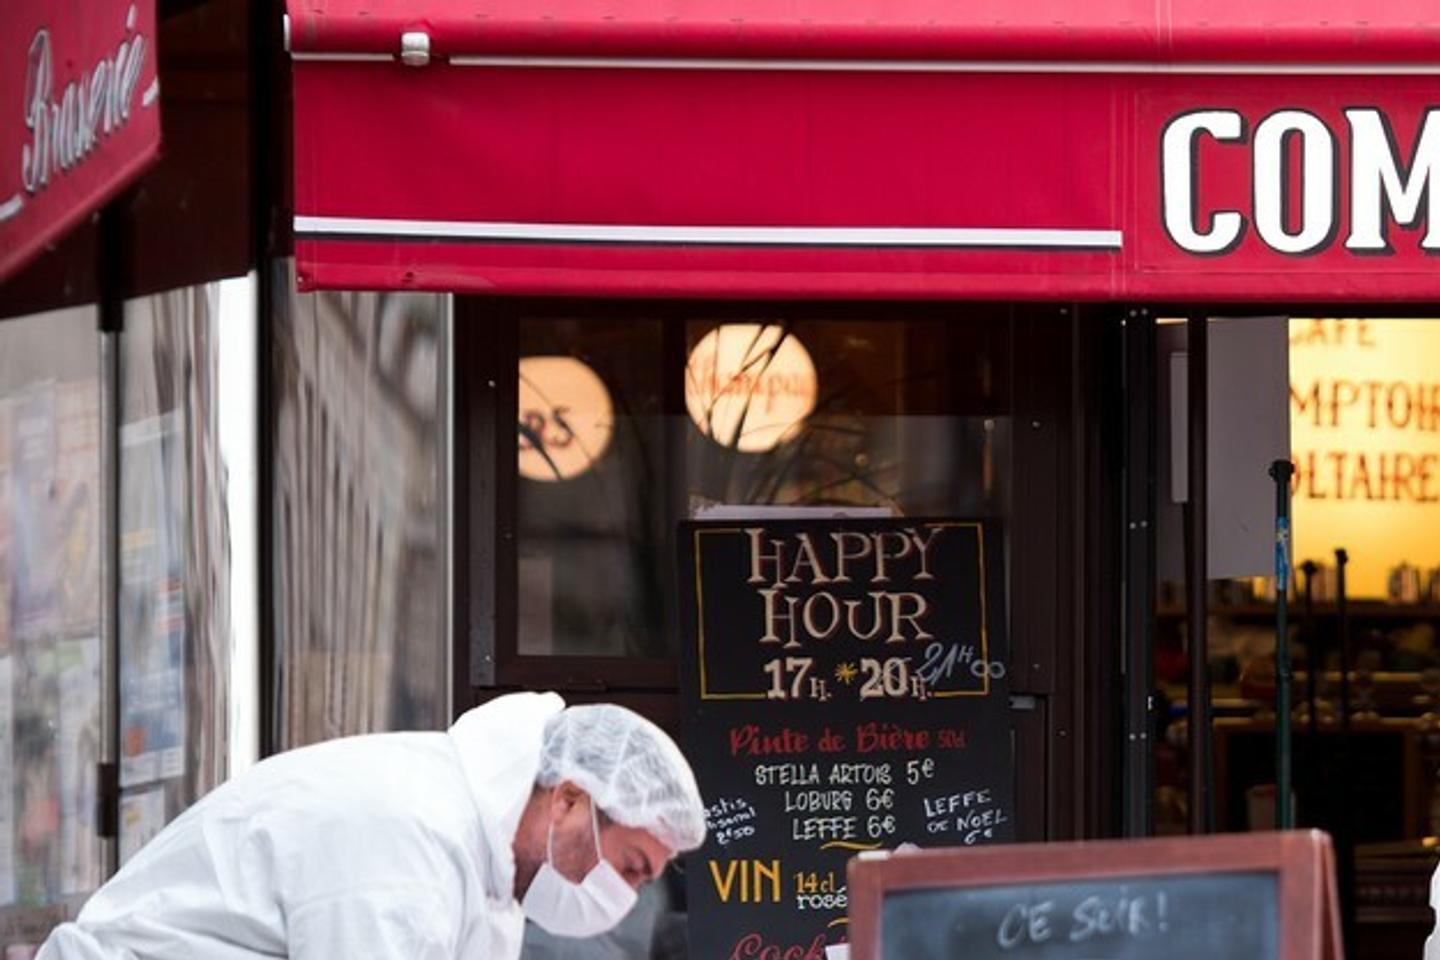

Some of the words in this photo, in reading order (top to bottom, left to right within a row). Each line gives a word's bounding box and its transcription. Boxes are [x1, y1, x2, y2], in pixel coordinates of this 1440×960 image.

[745, 527, 944, 589] HAPPY
[758, 589, 934, 648] HOUR
[729, 723, 809, 756] Pinte
[818, 727, 846, 751] de
[856, 721, 931, 752] Bière
[755, 763, 820, 785] STELLA
[829, 762, 892, 785] ARTOIS
[907, 757, 935, 784] 5€
[785, 790, 852, 812] LOBURG
[865, 788, 895, 811] 6€
[923, 788, 992, 818] LEFFE
[793, 817, 858, 840] LEFFE
[867, 815, 896, 838] 6€
[708, 860, 781, 902] VIN
[998, 900, 1054, 948] CE
